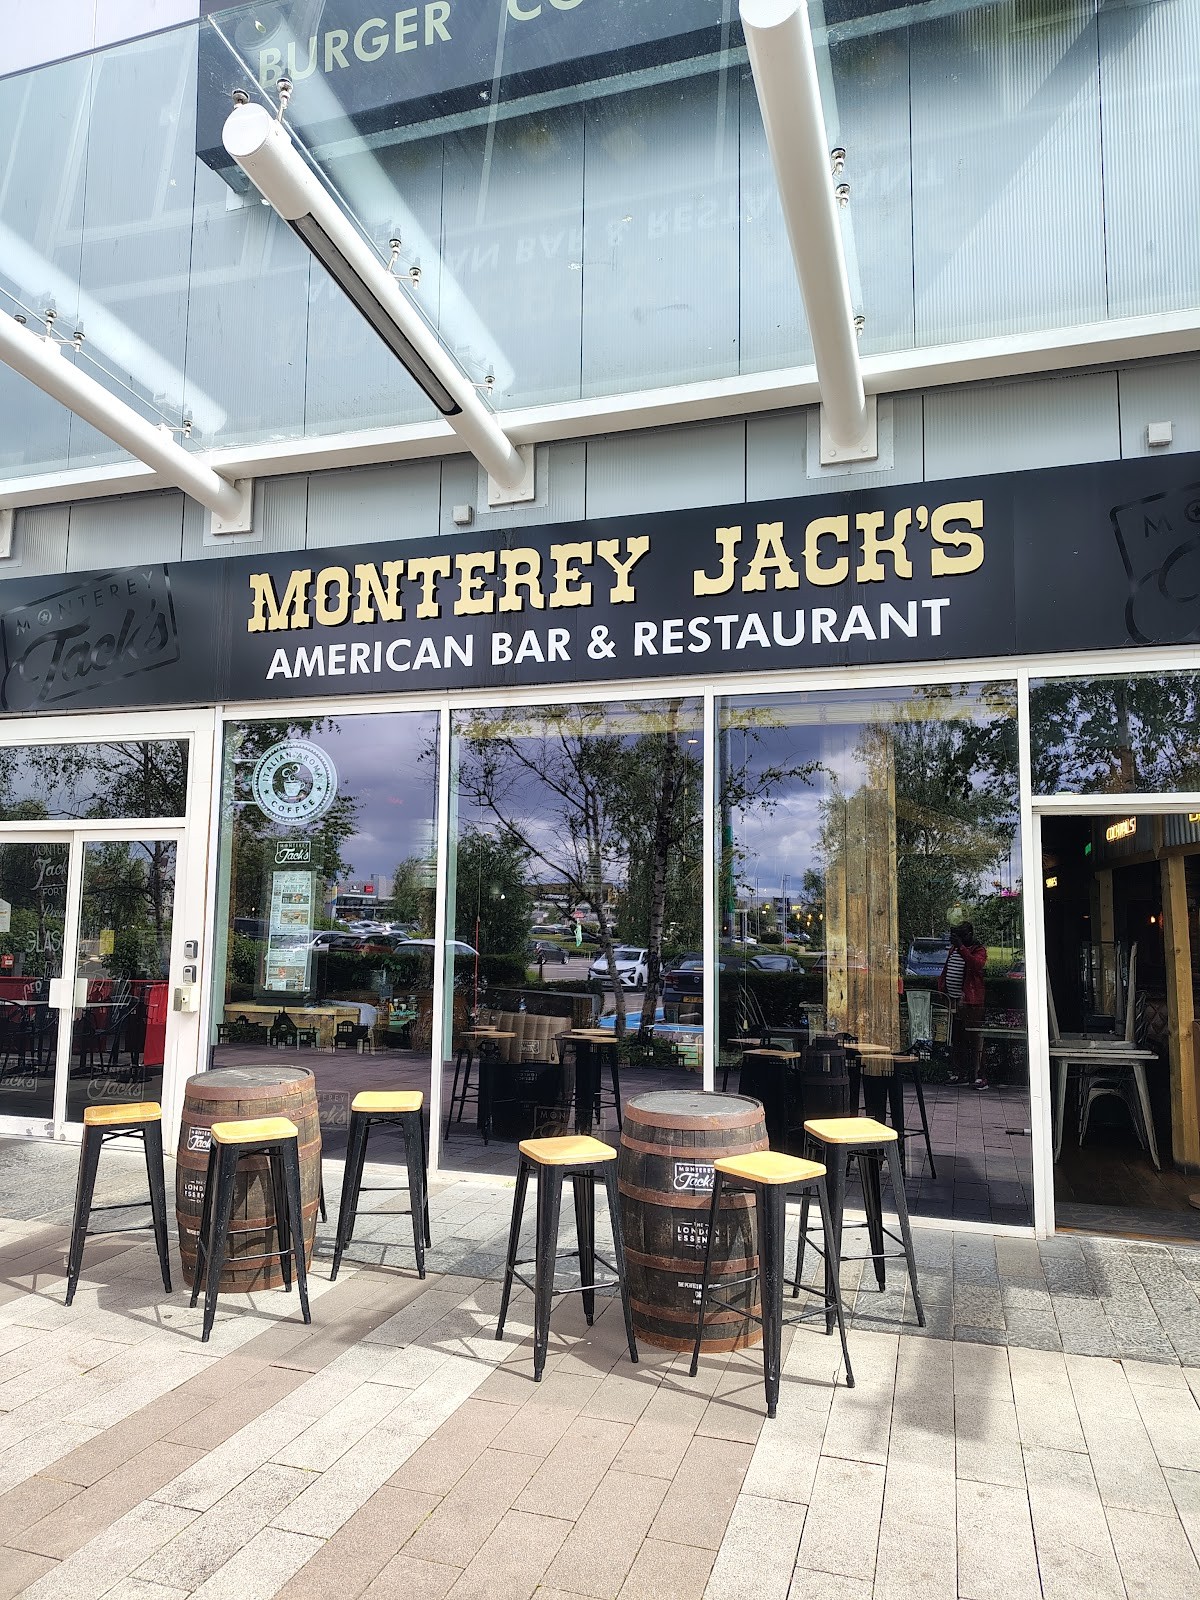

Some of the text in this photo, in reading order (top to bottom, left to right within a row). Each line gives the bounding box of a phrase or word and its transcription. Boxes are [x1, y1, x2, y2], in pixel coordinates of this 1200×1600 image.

[258, 0, 453, 89] BURGER
[247, 500, 985, 633] MONTEREY JACK'S
[16, 571, 153, 636] MONTEREY
[265, 598, 950, 680] AMERICAN BAR & RESTAURANT
[262, 752, 323, 782] ITALIAN AROMA
[271, 799, 316, 814] COFFEE
[275, 847, 309, 864] Jack's
[30, 857, 67, 890] Jack
[42, 887, 65, 897] FORT
[187, 1135, 211, 1150] Jack
[678, 1166, 715, 1174] MONTEREY
[184, 1183, 204, 1192] LOND
[184, 1190, 205, 1199] ESSEN
[677, 1226, 720, 1236] LONDN
[677, 1234, 720, 1244] ESSENE
